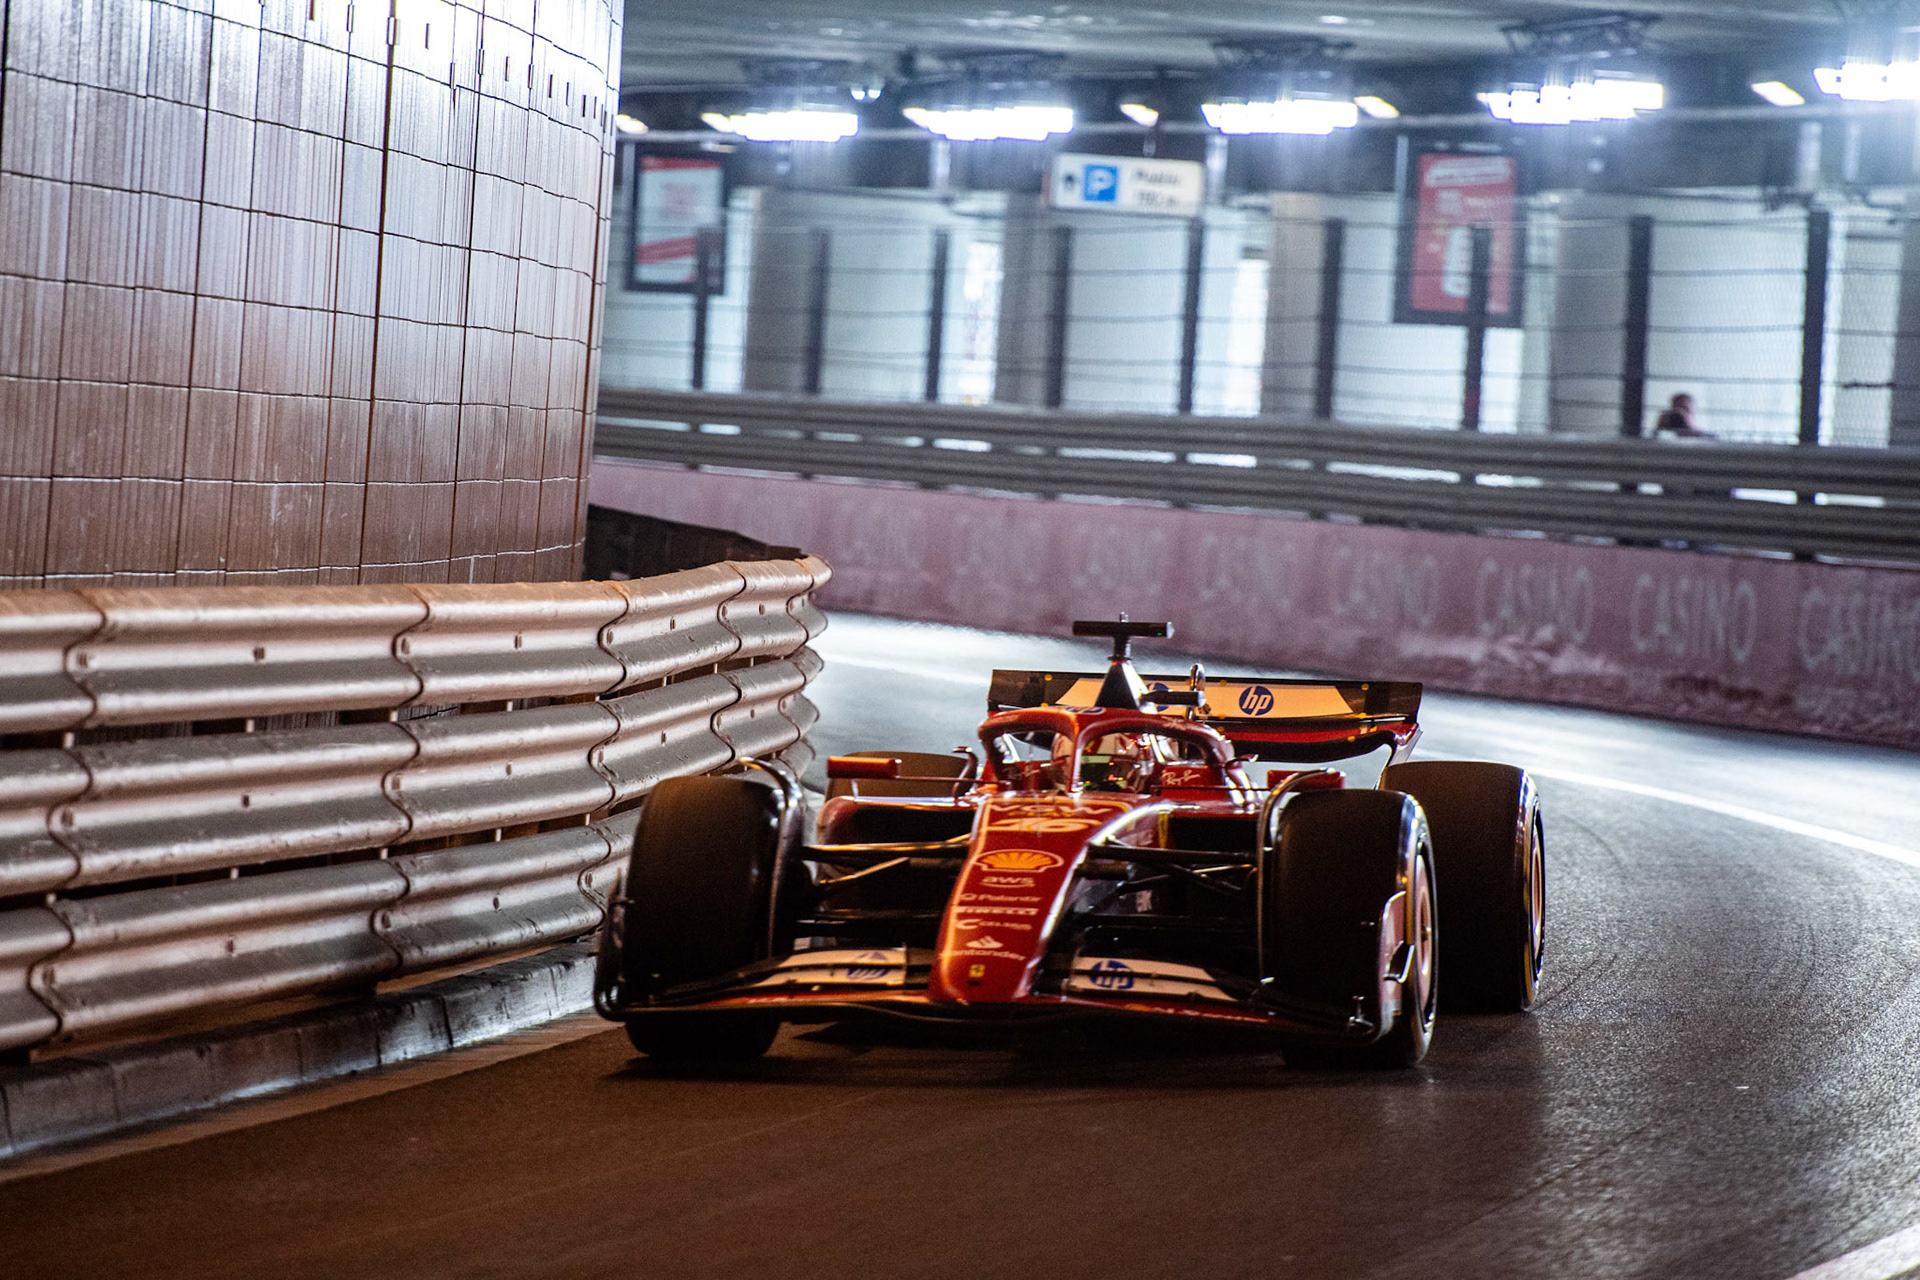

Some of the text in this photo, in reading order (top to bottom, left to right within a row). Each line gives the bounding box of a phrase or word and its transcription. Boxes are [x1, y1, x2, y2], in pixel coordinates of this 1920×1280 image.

[1087, 167, 1114, 200] P
[1631, 573, 1758, 664] CASINO
[1240, 686, 1273, 715] hp
[981, 876, 1035, 887] aws
[979, 893, 1043, 902] Palantir
